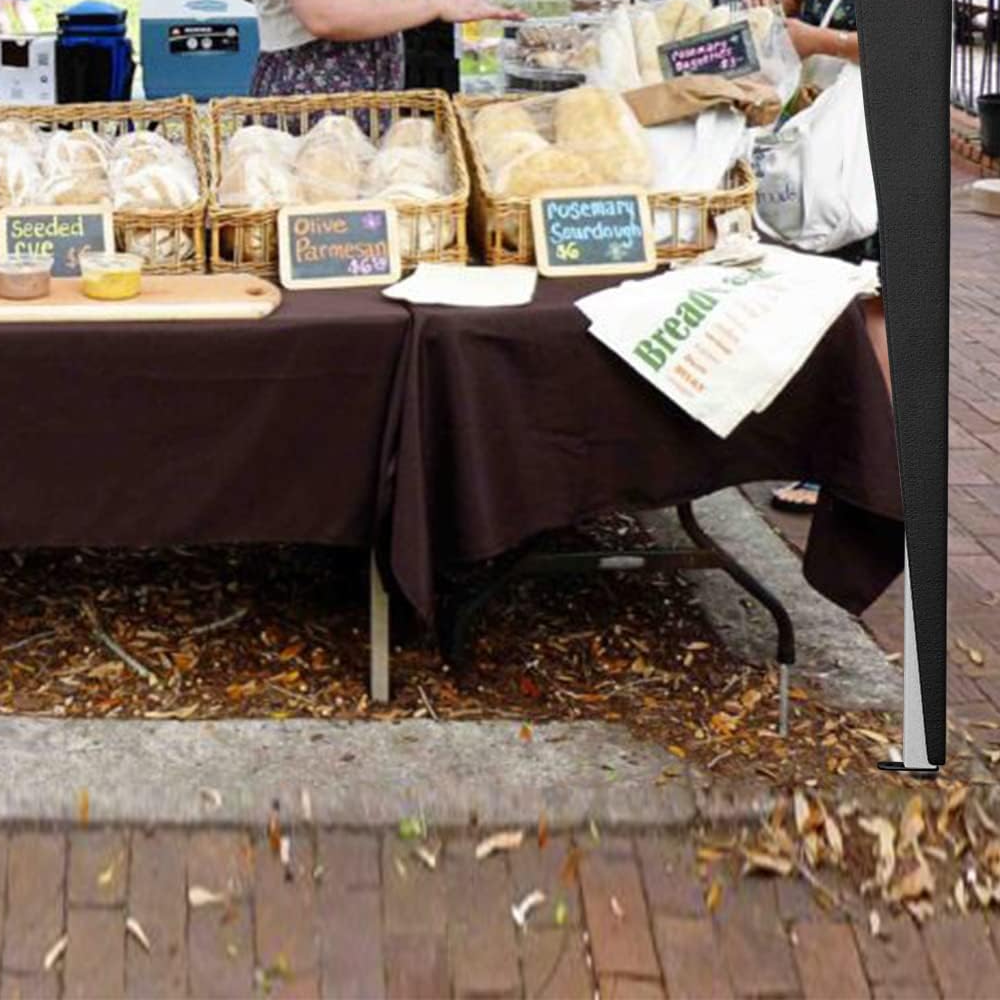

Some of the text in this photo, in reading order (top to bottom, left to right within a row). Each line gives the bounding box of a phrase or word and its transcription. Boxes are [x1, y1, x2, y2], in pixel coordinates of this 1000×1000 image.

[294, 217, 349, 236] Olive
[296, 237, 386, 263] Parmesan
[632, 290, 719, 371] Bread
